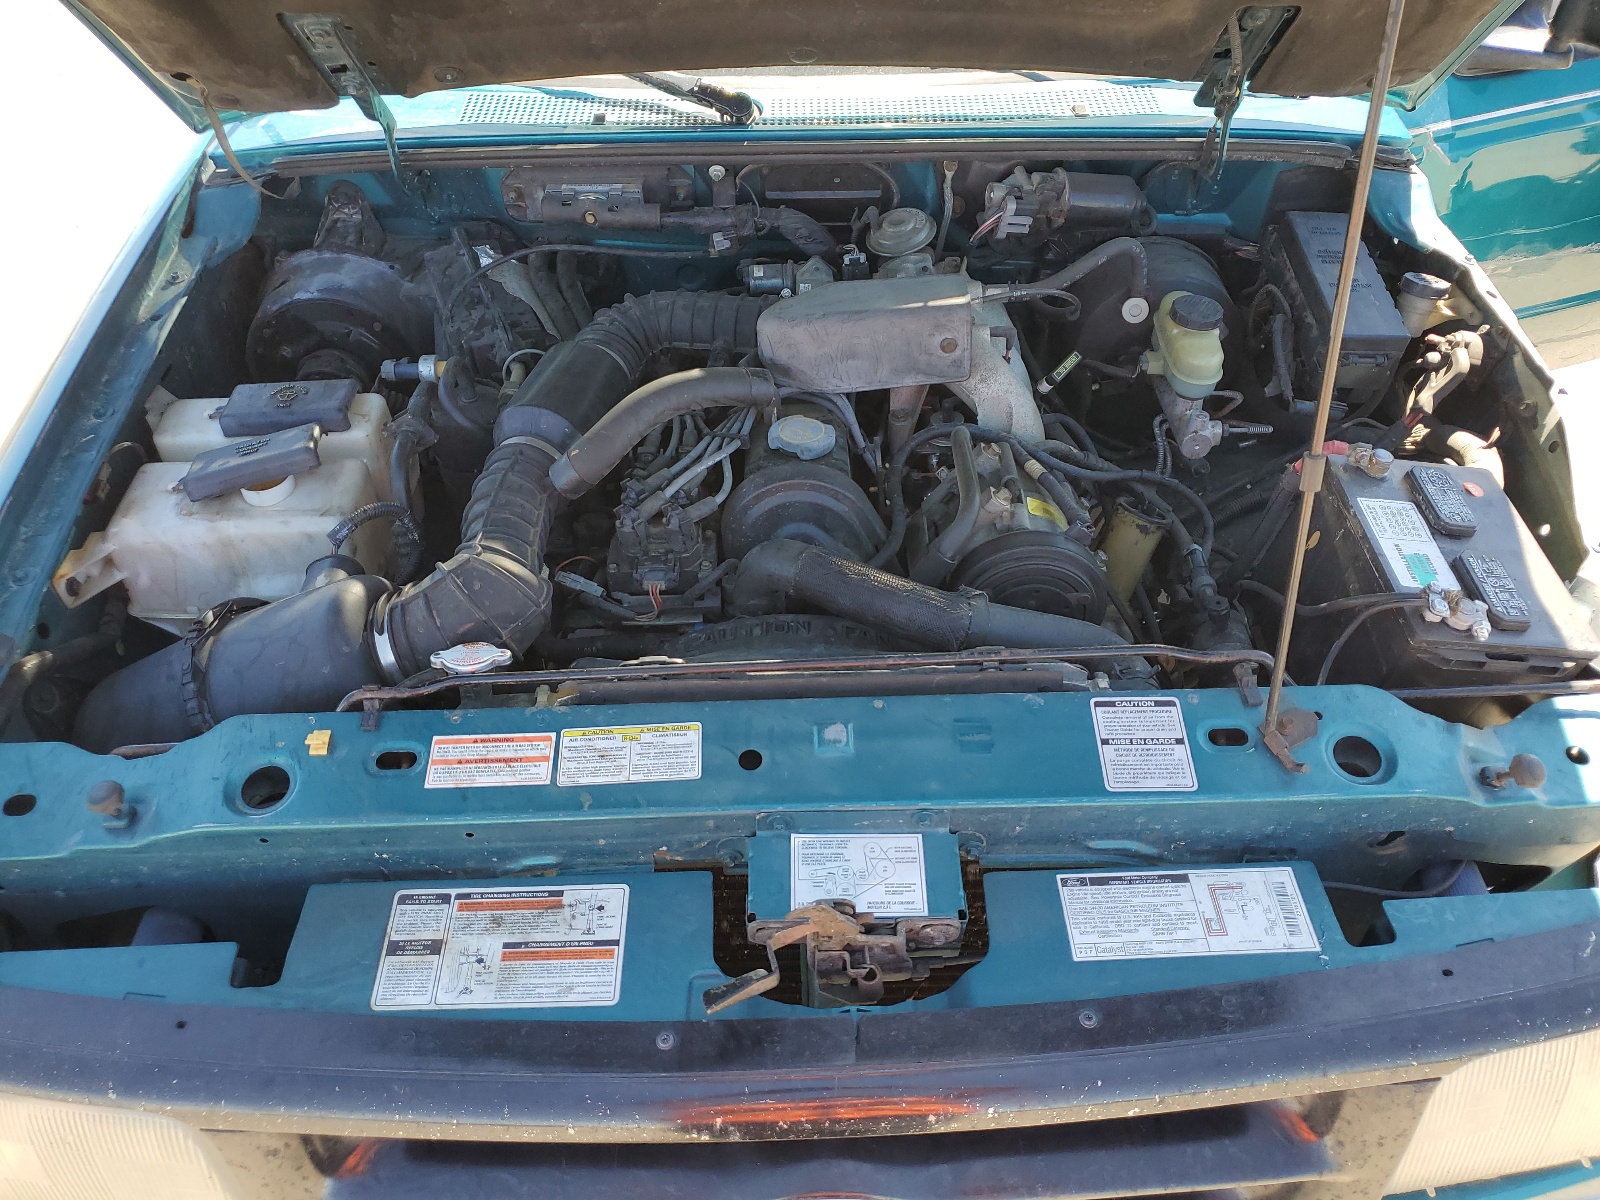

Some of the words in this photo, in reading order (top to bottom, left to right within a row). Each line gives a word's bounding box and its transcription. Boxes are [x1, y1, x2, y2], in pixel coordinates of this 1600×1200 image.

[1394, 544, 1418, 582] INSTALLATION
[1422, 554, 1439, 576] RECORD
[1097, 946, 1124, 954] Catalyst
